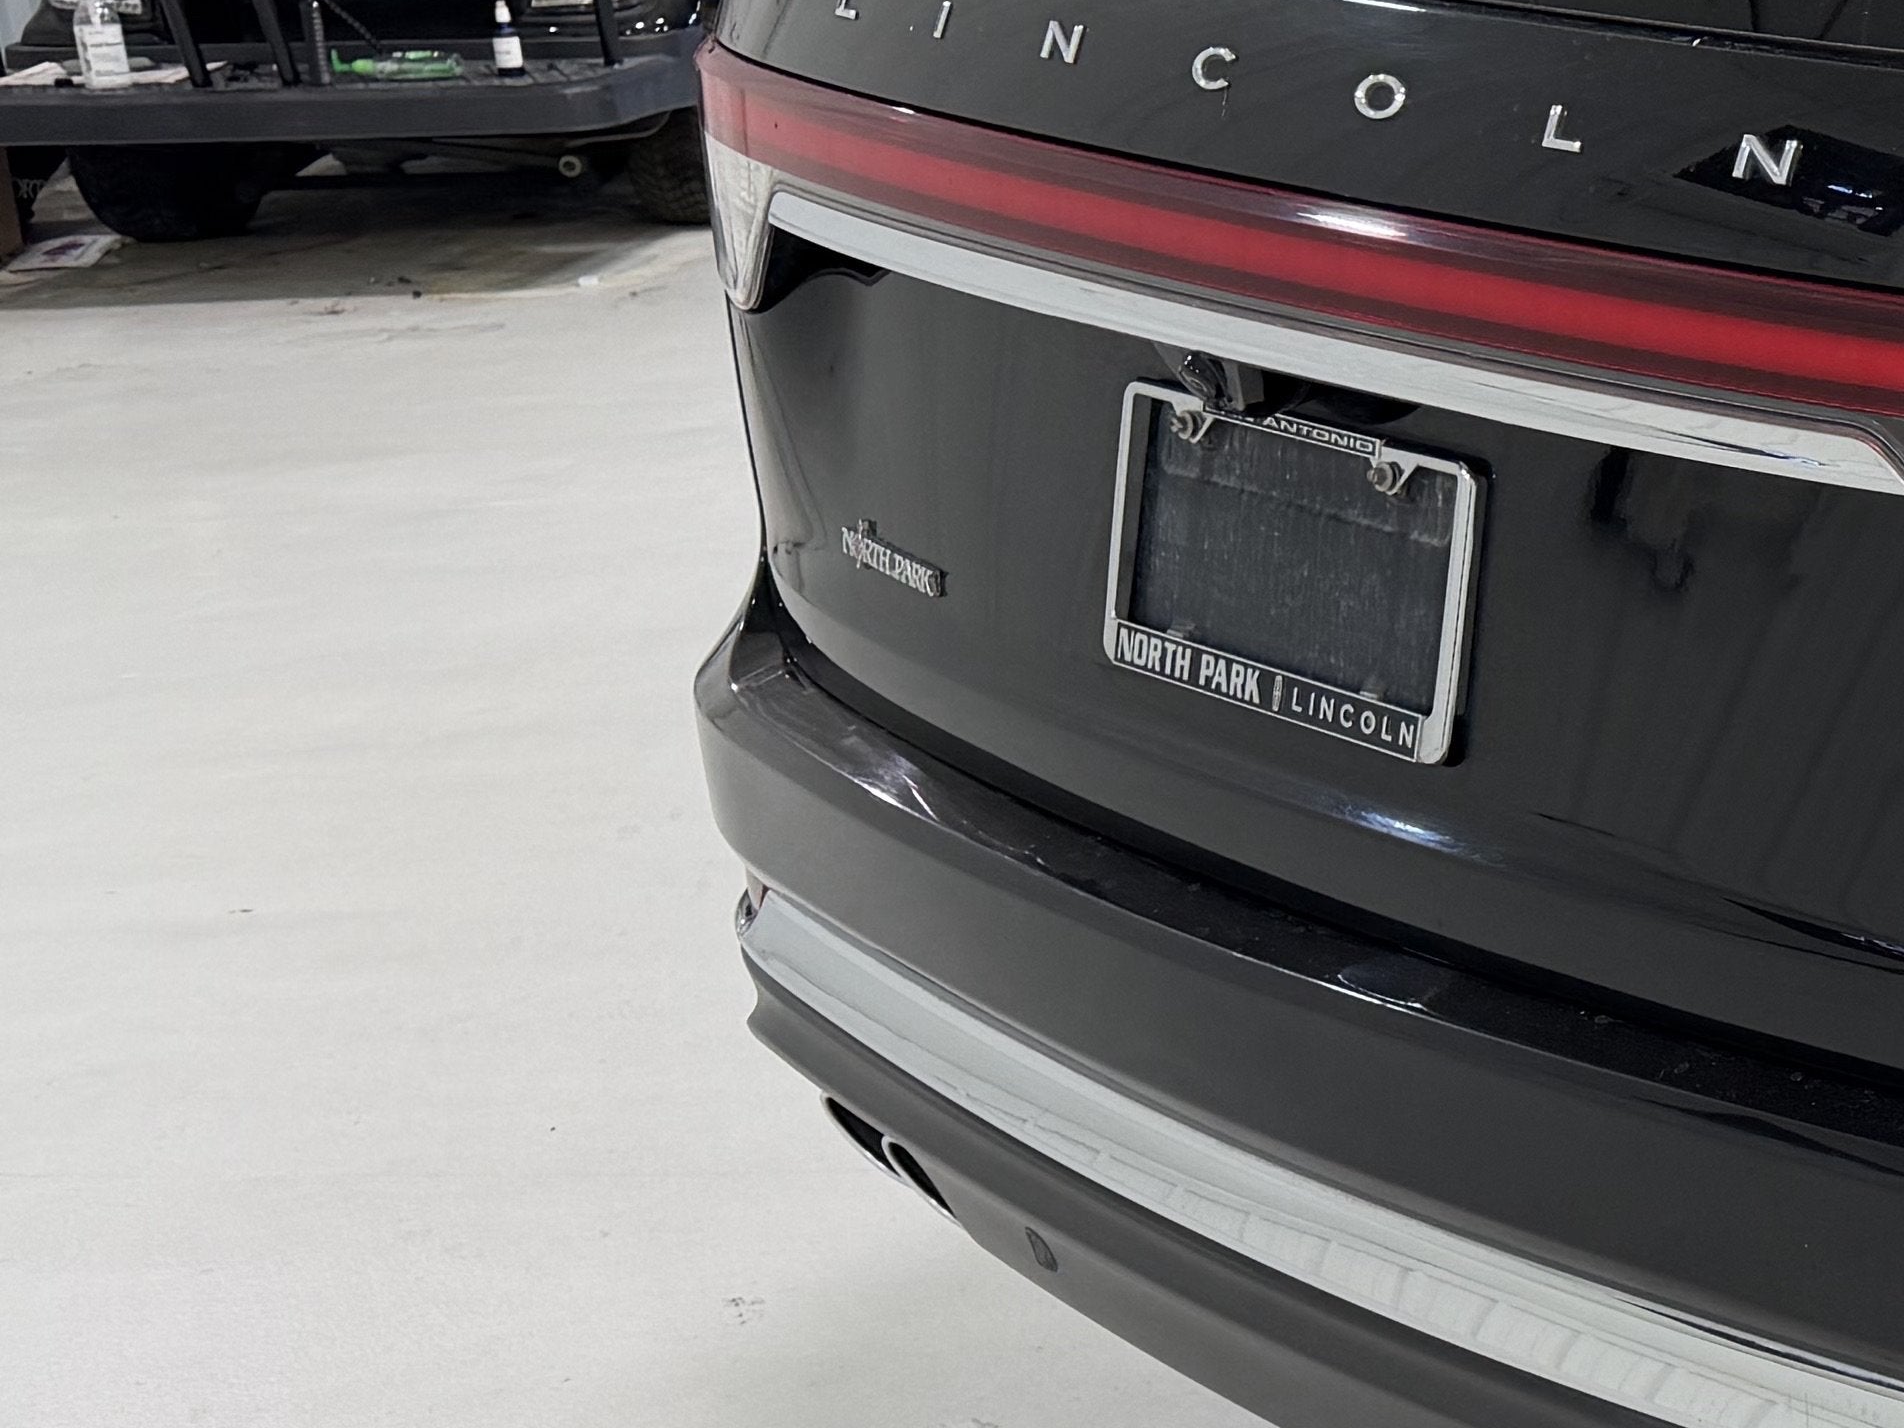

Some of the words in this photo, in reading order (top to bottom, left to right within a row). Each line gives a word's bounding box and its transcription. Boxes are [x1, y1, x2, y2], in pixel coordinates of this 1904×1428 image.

[1262, 416, 1374, 453] ANTONIO
[890, 553, 935, 598] PARK
[1116, 626, 1192, 681] NORTH
[1199, 653, 1262, 704] PARK
[1290, 686, 1415, 750] LINCOLN
